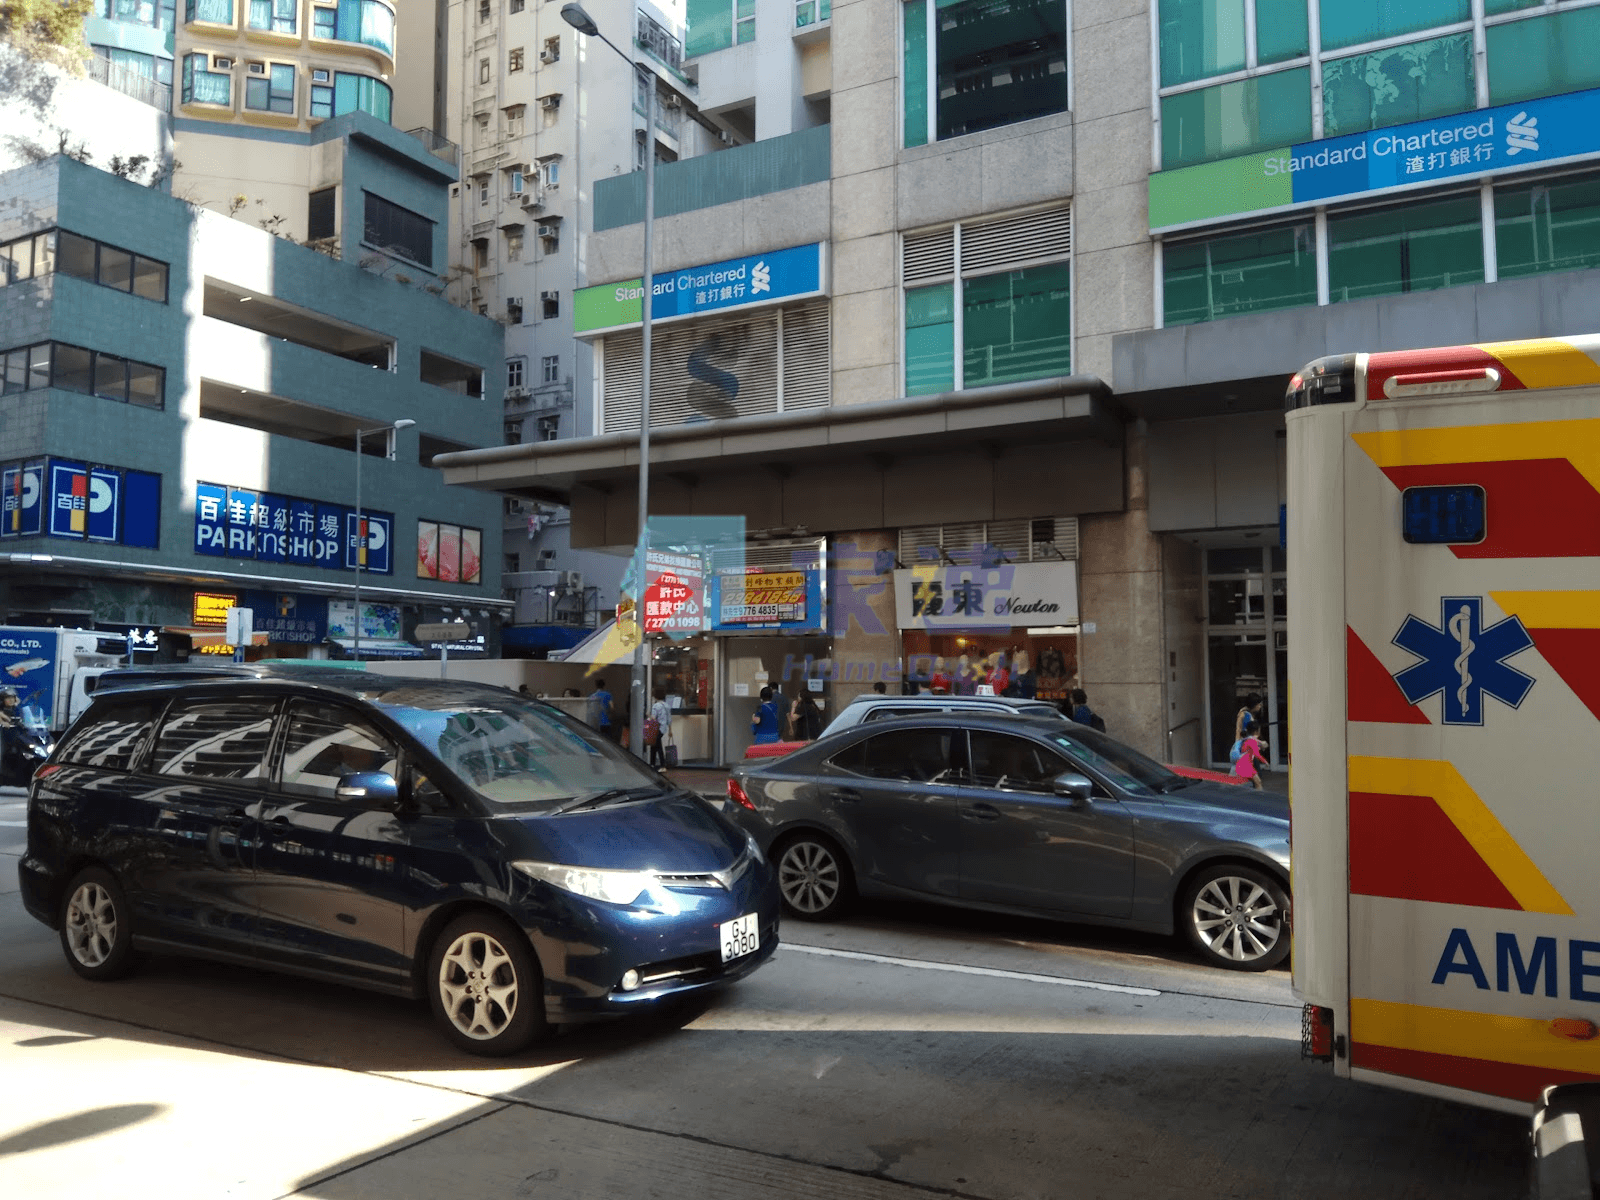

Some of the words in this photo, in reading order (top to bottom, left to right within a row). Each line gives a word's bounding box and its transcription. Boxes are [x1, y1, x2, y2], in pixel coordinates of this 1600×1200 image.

[1263, 141, 1367, 177] Standard
[1372, 117, 1494, 157] Chartered
[1405, 142, 1495, 175] 渣打銀行
[614, 277, 675, 302] Stanard
[677, 264, 746, 291] Chartered
[695, 283, 746, 305] 渣打銀行
[198, 494, 339, 539] 百佳超級市場
[660, 587, 686, 598] 許氏
[646, 600, 699, 616] 匯款中心
[758, 605, 776, 615] 4835
[994, 597, 1061, 615] Newton
[651, 618, 675, 628] 2770
[677, 617, 700, 627] 1098
[0, 639, 20, 649] CO.,
[21, 639, 42, 649] LTD.
[732, 917, 748, 938] GJ
[725, 933, 756, 959] 3080
[1431, 927, 1600, 1003] AME
